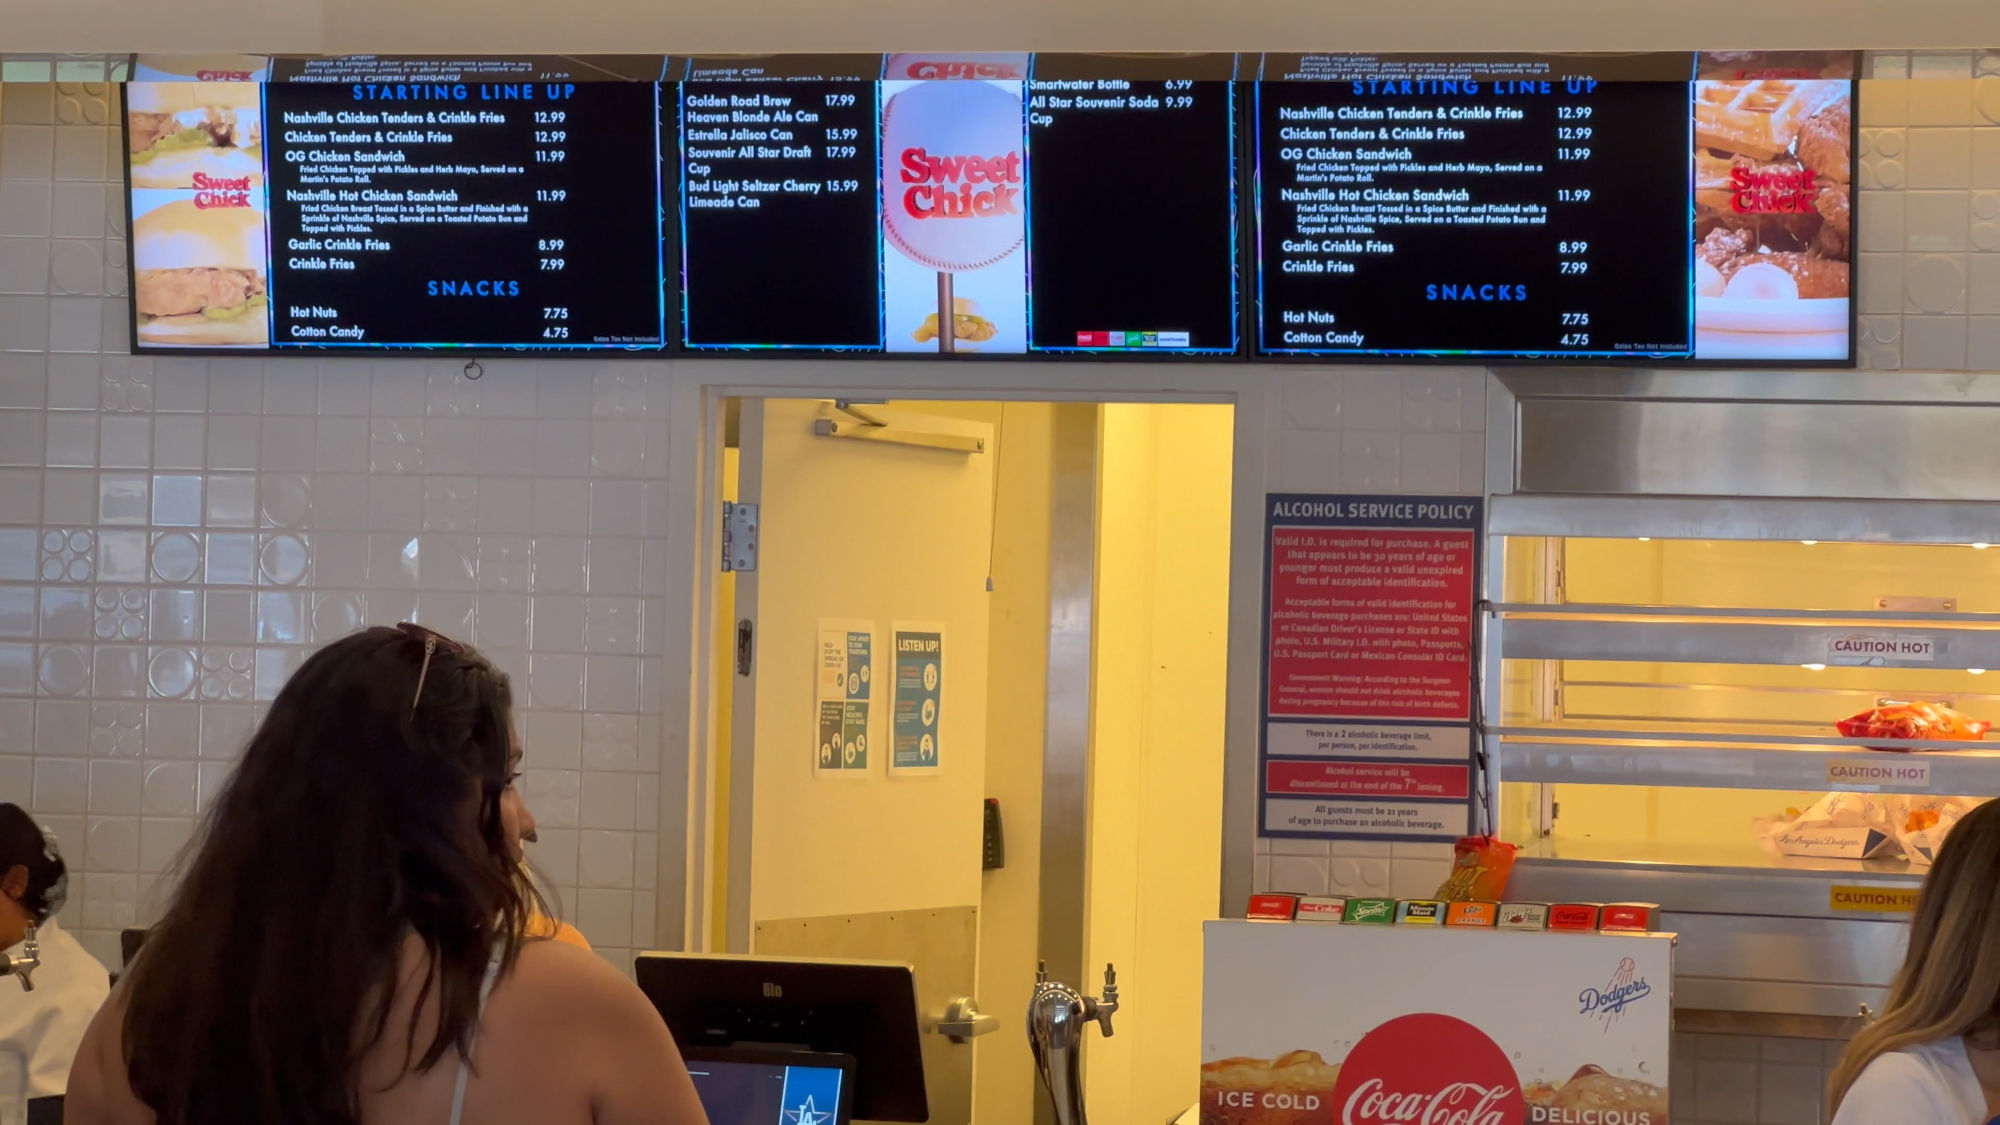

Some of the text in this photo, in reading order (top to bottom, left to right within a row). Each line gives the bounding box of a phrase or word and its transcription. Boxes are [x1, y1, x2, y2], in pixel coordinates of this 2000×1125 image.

[1029, 80, 1192, 90] Smartwater Bottle 6.99
[1353, 81, 1597, 95] STARTING LINE UP
[353, 84, 575, 100] STARTING LINE UP
[687, 94, 855, 107] Golden Road Brew 17.99
[1029, 95, 1193, 108] All Star Souvenir Soda 9.99
[284, 111, 565, 124] Nashville Chicken Tenders & Crinkle Fries 12.99
[687, 110, 818, 123] Heaven Blonde Ale Can
[1029, 112, 1053, 127] Cup
[1280, 106, 1592, 120] Nashville Chicken Tenders & Crinkle Fries 12.99
[688, 128, 858, 141] Estrella Jalisco Can 15.99
[1280, 126, 1592, 140] Chicken Tenders & Crinkle Fries 12.99
[285, 149, 565, 162] OG Chicken Sandwich 11.99
[688, 145, 856, 158] Souvenir All Star Draft 17.99
[1280, 147, 1591, 160] OG Chicken Sandwich 11.99
[688, 162, 711, 177] Cup
[901, 147, 1020, 184] Sweet
[193, 171, 251, 191] Sweet
[689, 179, 858, 195] Bud Light Seltzer Cherry 15.99
[194, 190, 251, 210] Chick
[286, 189, 566, 202] Nashville Hot Chicken Sandwich 11.99
[1281, 188, 1591, 201] Nashville Hot Chicken Sandwich 11.99
[689, 196, 760, 208] Limeade Can
[903, 183, 1019, 220] Chick
[288, 238, 564, 251] Garlic Crinkle Fries 8.99
[1282, 239, 1588, 253] Garlic Crinkle Fries 8.99
[289, 257, 565, 270] Crinkle Fries 7.99
[1282, 259, 1588, 274] Crinkle Fries 7.99
[428, 280, 519, 296] SNACKS
[1426, 284, 1527, 301] SNACKS
[290, 306, 568, 319] Hot Nuts 7.75
[1283, 310, 1589, 325] Hot Nuts 7.75
[291, 325, 568, 340] Cotton Candy 4.75
[1283, 331, 1589, 347] Cotton Candy 4.75
[1273, 502, 1474, 519] ALCOHOL SERVICE POLICY
[899, 639, 939, 652] LISTEN UP!
[1835, 641, 1930, 653] CAUTION HOT
[1830, 767, 1926, 779] CAUTION HOT
[1315, 805, 1326, 813] All
[1327, 807, 1353, 816] guests
[1375, 807, 1385, 815] be
[1288, 816, 1297, 824] of
[1297, 818, 1312, 826] age
[1313, 817, 1321, 825] to
[1322, 817, 1358, 826] purchase
[1371, 819, 1404, 827] alcoholic
[1835, 893, 1898, 905] CAUTION
[1314, 904, 1339, 913] Coke
[1358, 906, 1385, 915] Sprite
[1579, 977, 1650, 1014] Dodgers
[1218, 1091, 1320, 1111] ICE COLD
[1342, 1078, 1515, 1125] Coca-Cola
[1532, 1106, 1651, 1125] DELICIOUS
